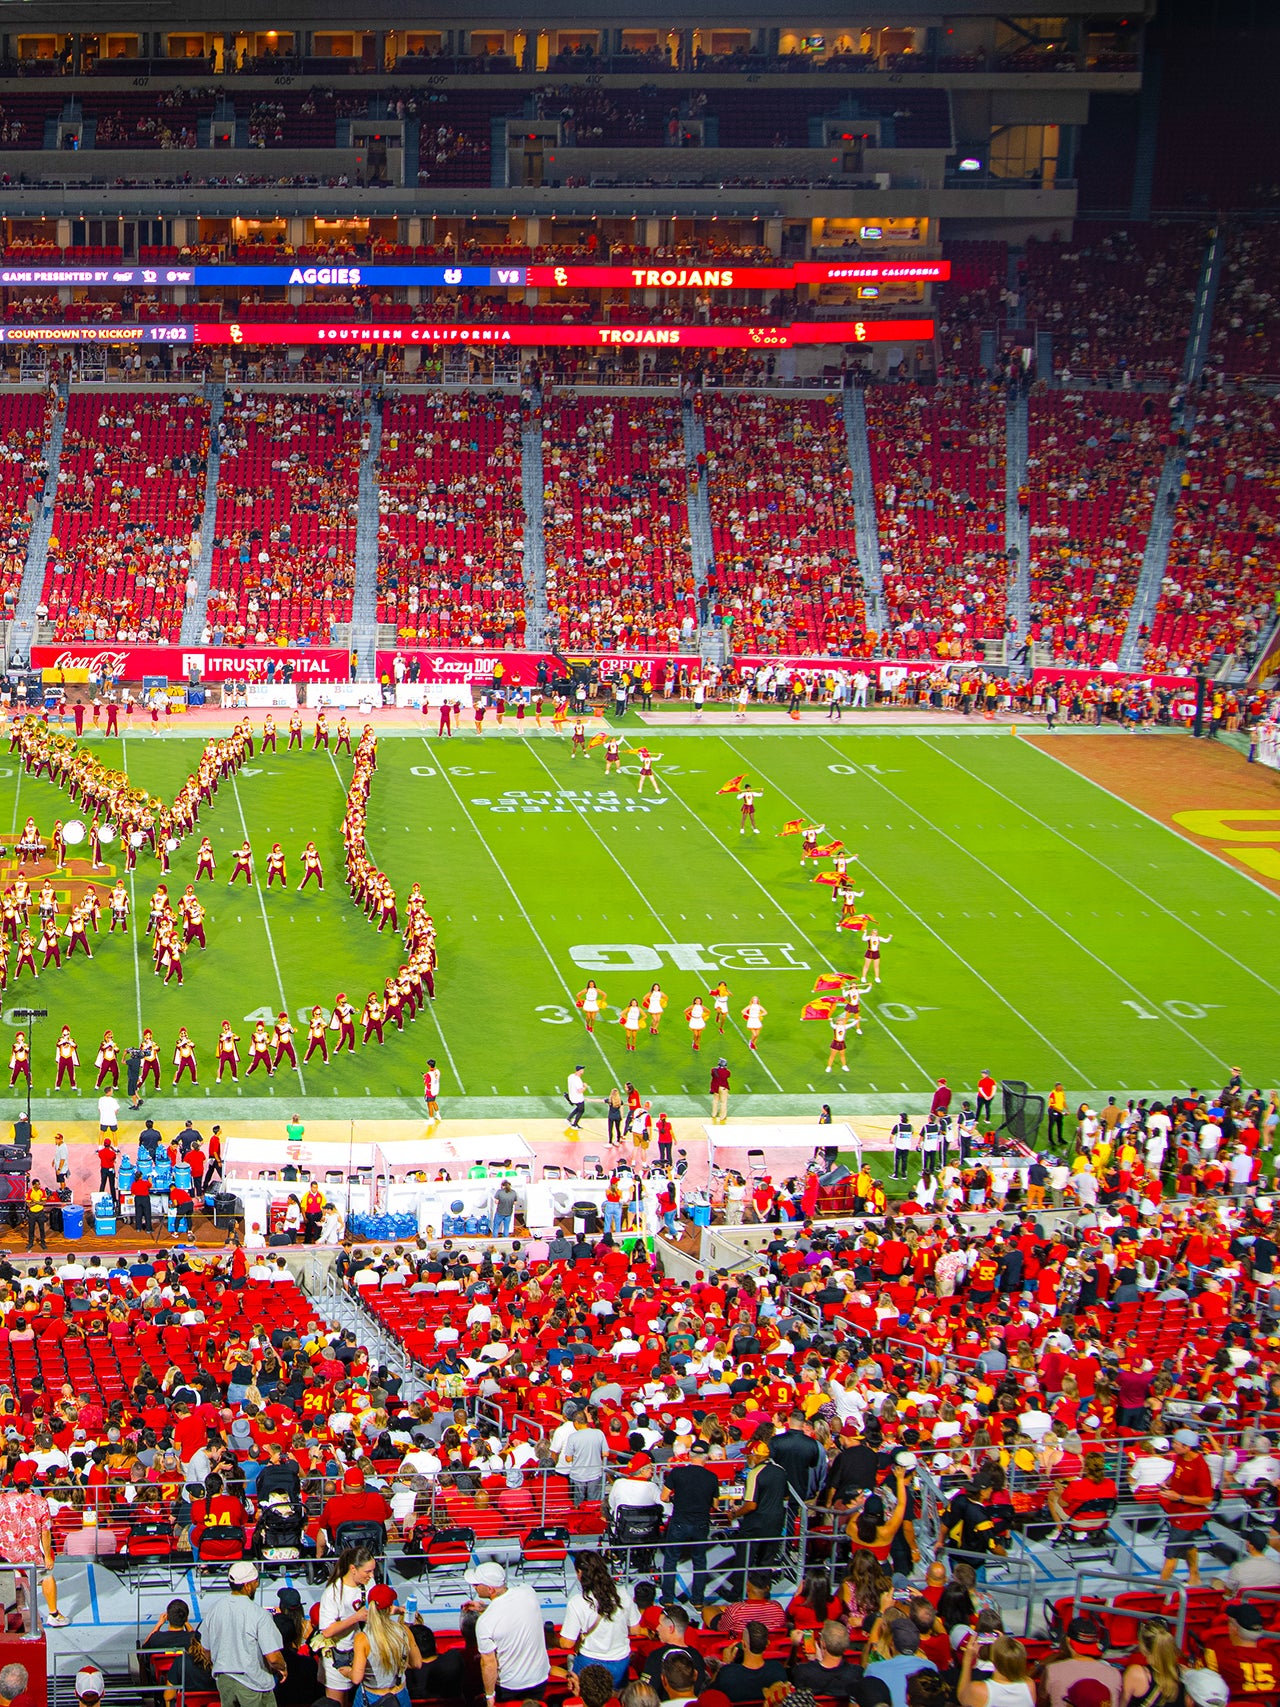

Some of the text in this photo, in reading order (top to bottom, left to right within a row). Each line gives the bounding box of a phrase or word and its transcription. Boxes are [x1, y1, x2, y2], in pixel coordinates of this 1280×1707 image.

[132, 77, 149, 87] 407
[274, 76, 291, 86] 408
[427, 75, 445, 85] 409
[2, 272, 32, 282] GAME
[33, 271, 94, 282] PRESENTED
[95, 271, 109, 281] BY
[288, 268, 361, 284] AGGIES
[497, 270, 519, 284] VS
[631, 269, 734, 287] TROJANS
[7, 327, 187, 340] COUNTDOWN TO KICKOFF 17:02
[318, 329, 511, 340] SOUTHERN CALIFORNIA
[599, 329, 680, 344] TROJANS
[431, 656, 473, 681] Lazy
[1120, 999, 1209, 1020] 10
[922, 1253, 929, 1268] 1
[303, 1393, 324, 1411] 24
[777, 1387, 788, 1403] 9
[1102, 1405, 1115, 1424] 2
[1240, 1662, 1276, 1692] 15
